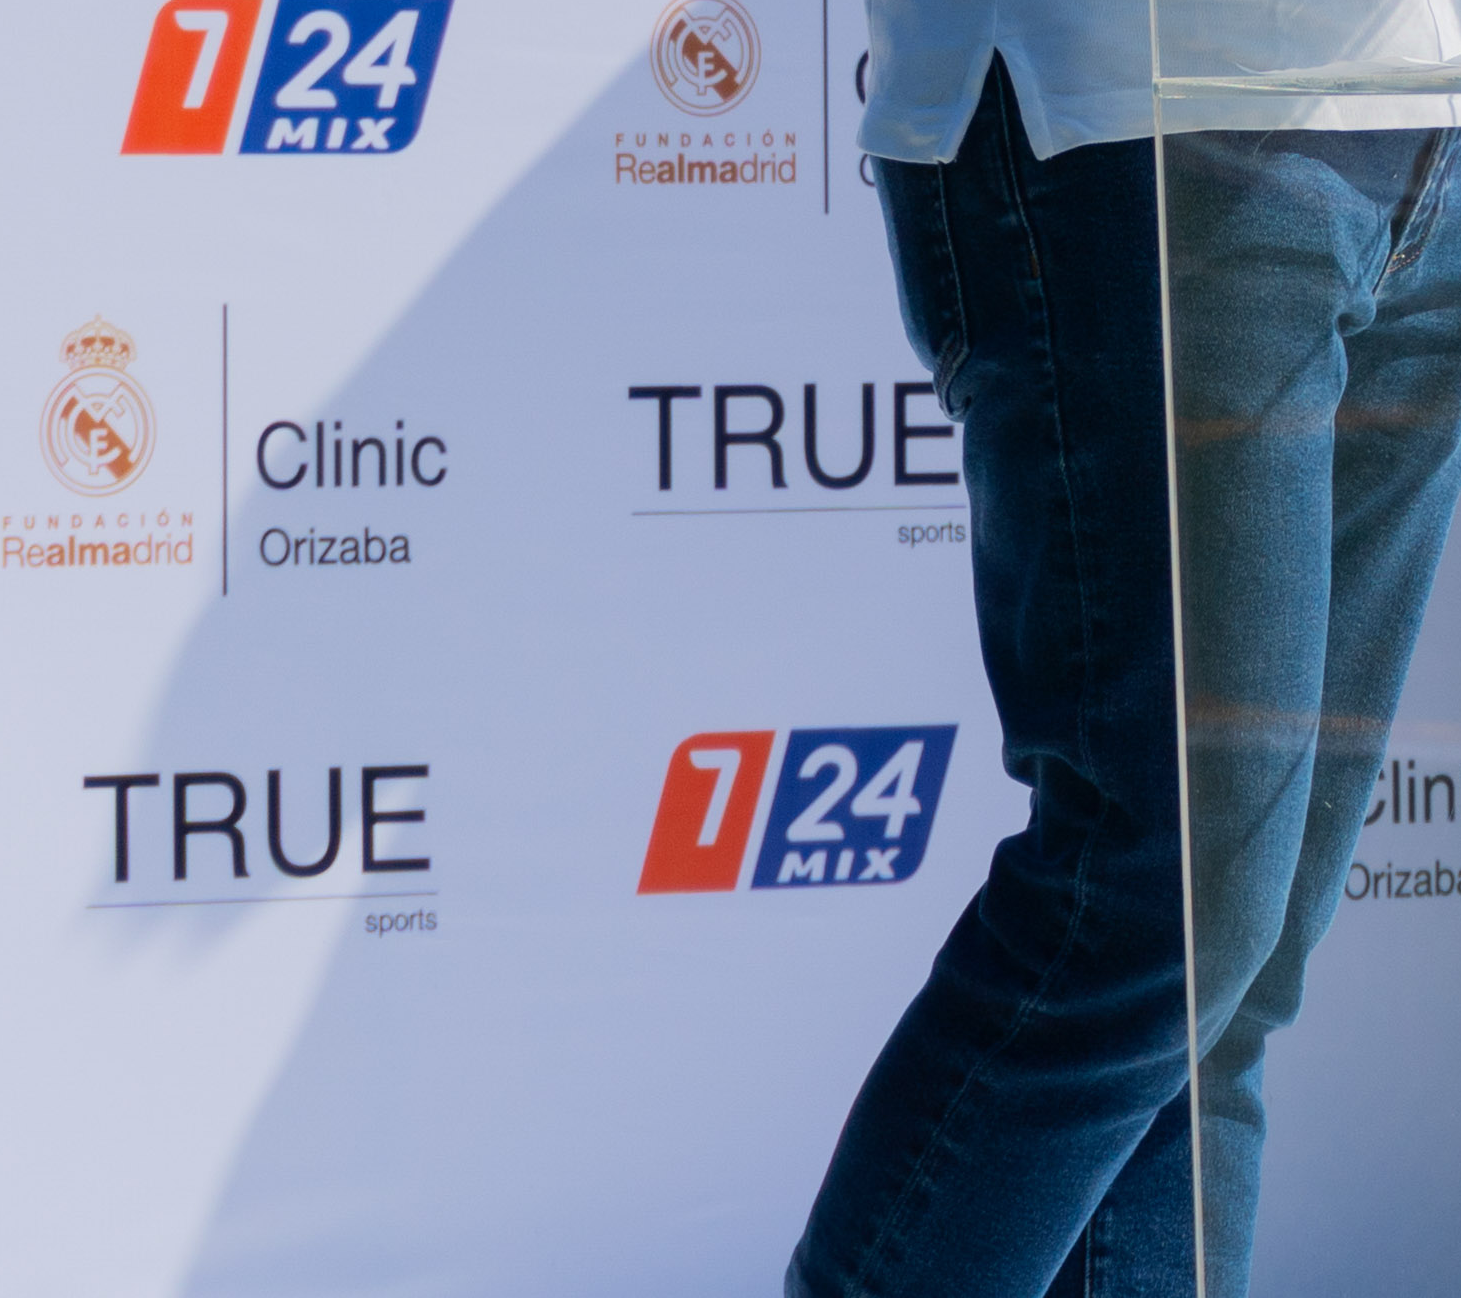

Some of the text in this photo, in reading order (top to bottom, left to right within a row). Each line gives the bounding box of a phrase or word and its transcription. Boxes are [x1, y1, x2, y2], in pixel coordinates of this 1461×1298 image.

[274, 10, 419, 110] 24
[267, 116, 393, 152] MIX
[616, 129, 796, 147] FUNDACIÓN
[616, 153, 796, 184] Realmadrid
[628, 381, 961, 490] TRUE
[257, 420, 446, 490] Clinic
[3, 509, 193, 530] FUNDACIÓN
[898, 520, 967, 548] sports
[3, 534, 192, 567] Realmadrid
[260, 527, 411, 566] Orizaba
[785, 740, 924, 842] 24
[84, 765, 430, 882] TRUE
[776, 847, 899, 884] MIX
[365, 909, 437, 938] sports
